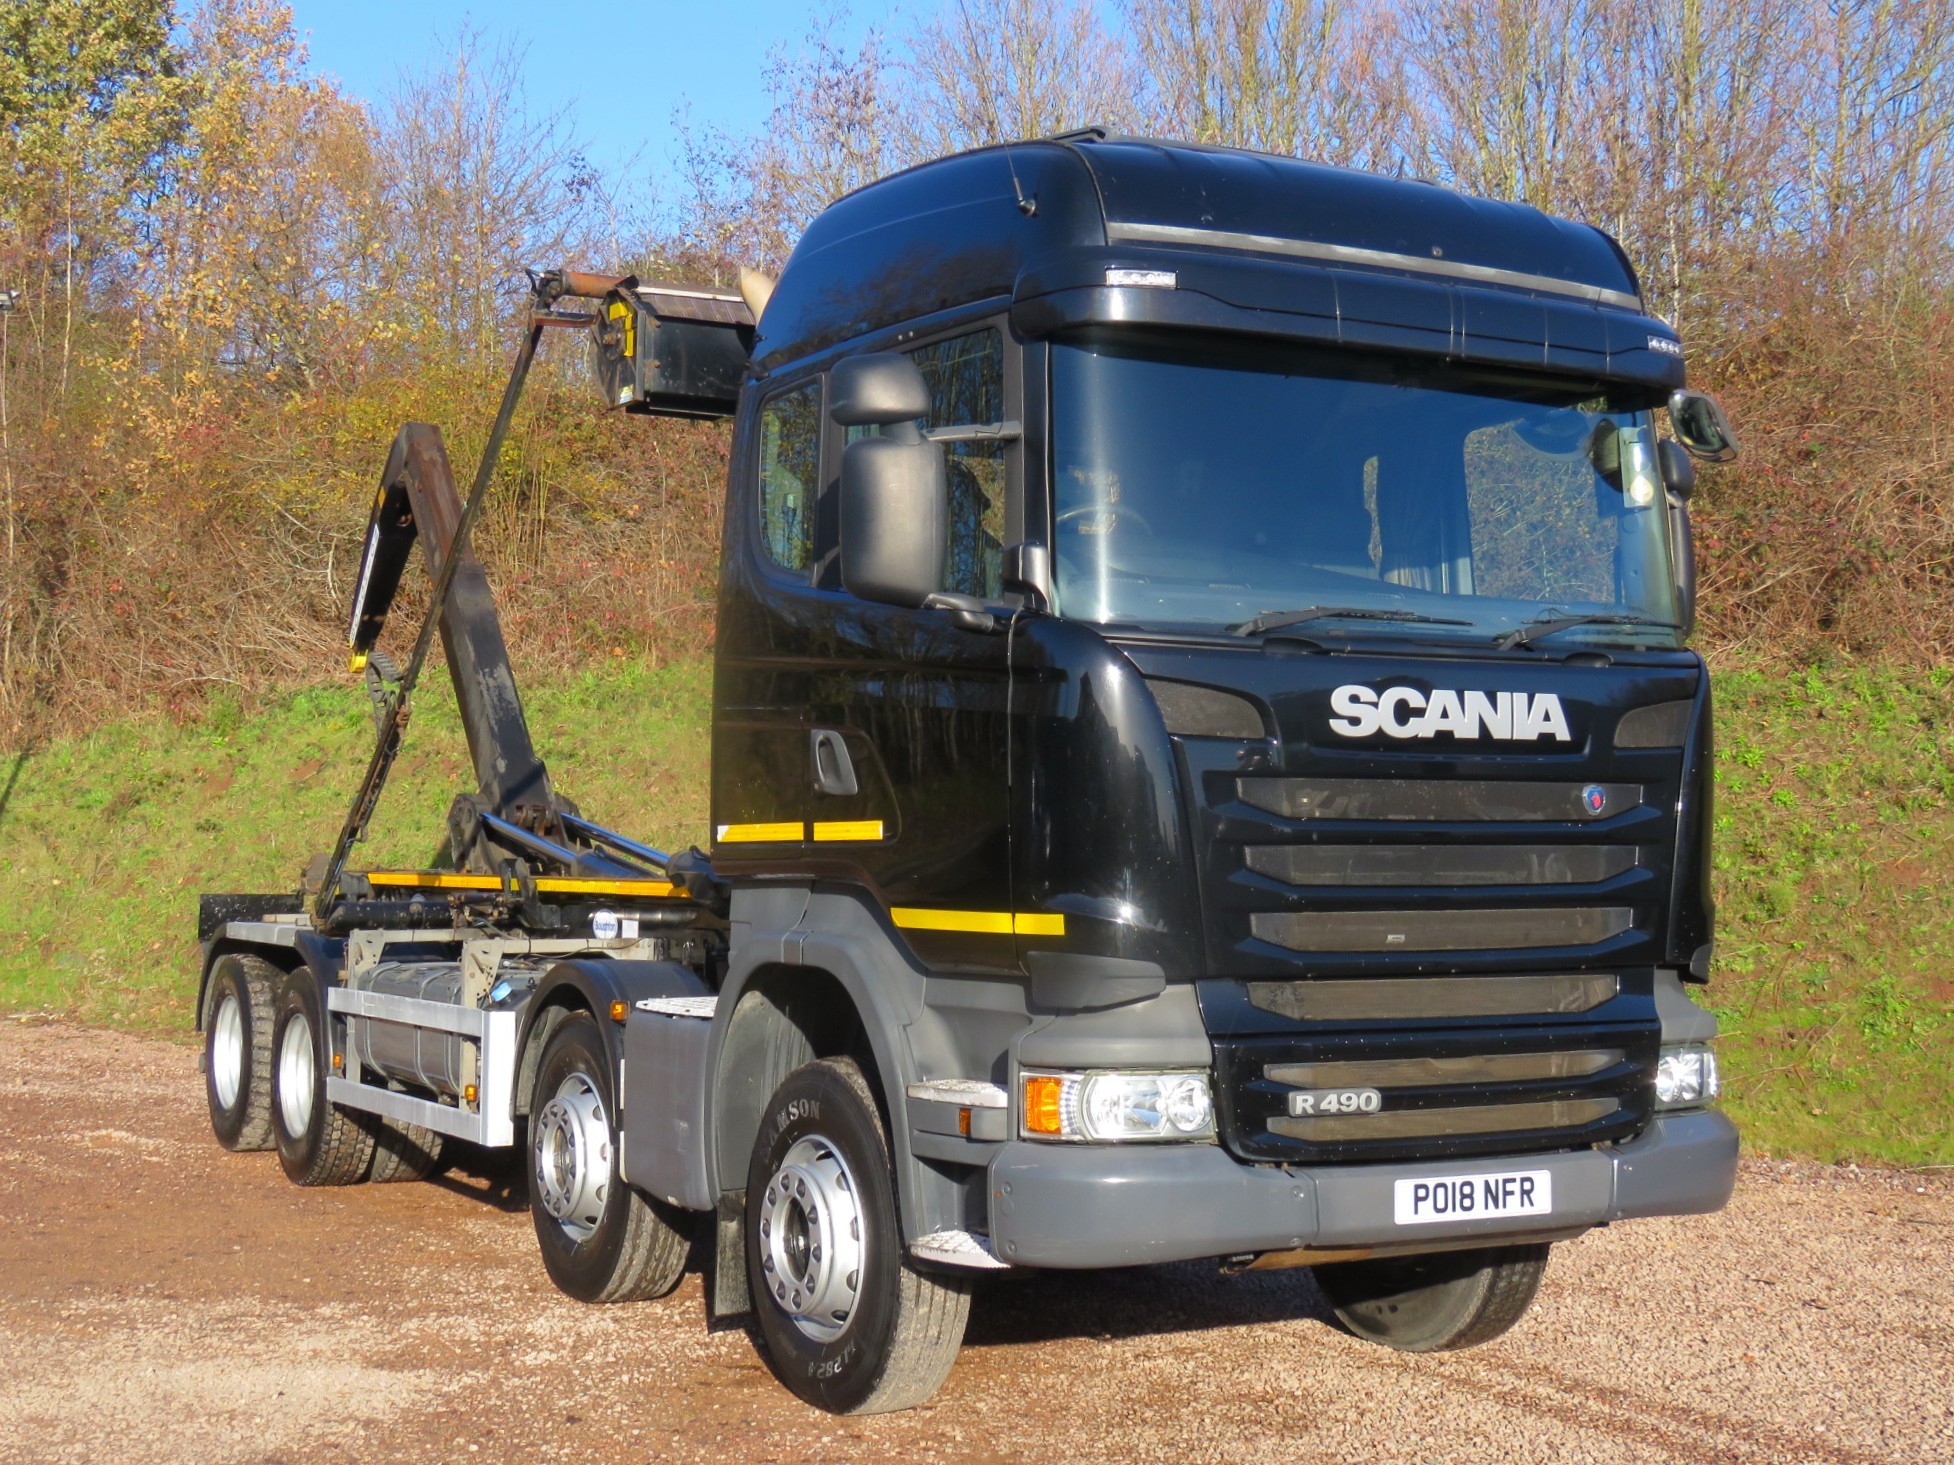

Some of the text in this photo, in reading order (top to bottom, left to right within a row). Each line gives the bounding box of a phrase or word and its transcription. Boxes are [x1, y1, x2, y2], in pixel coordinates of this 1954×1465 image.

[1329, 685, 1571, 741] SCANIA
[1295, 1092, 1378, 1114] R 490
[1413, 1176, 1535, 1215] PO18 NFR
